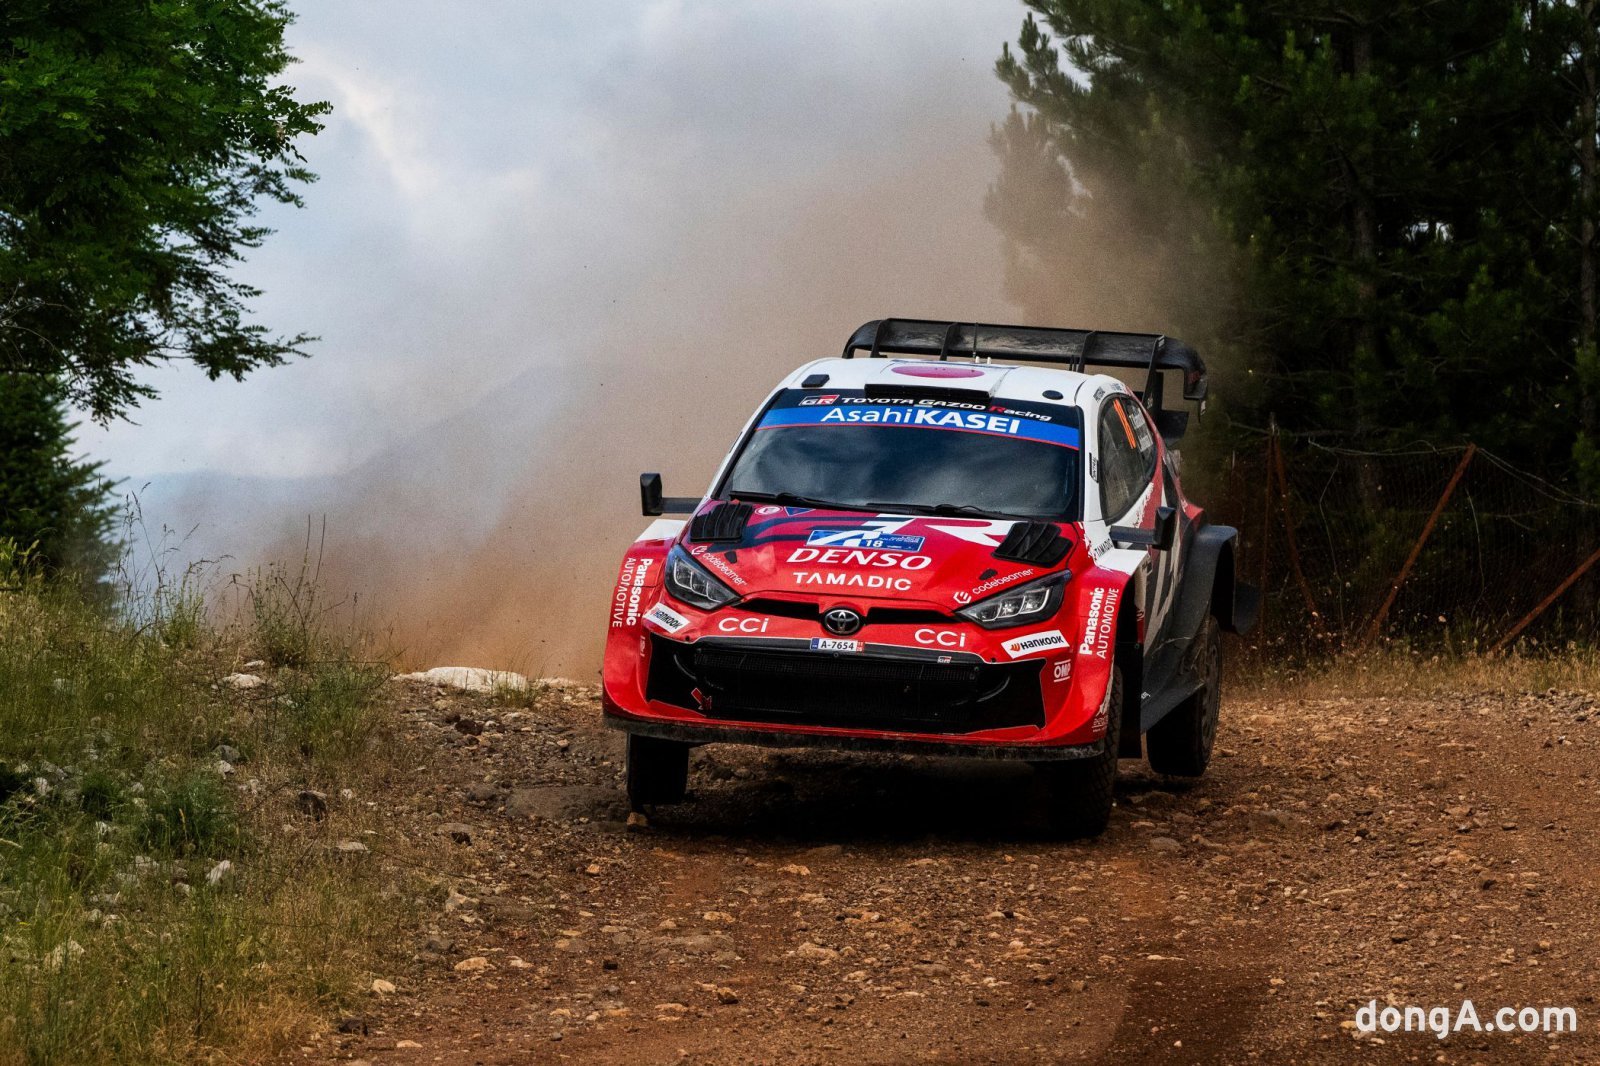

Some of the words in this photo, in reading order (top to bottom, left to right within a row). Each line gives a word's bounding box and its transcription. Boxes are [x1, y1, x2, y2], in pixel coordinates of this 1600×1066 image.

[800, 396, 838, 406] GR
[841, 397, 914, 406] TOYOTA
[918, 399, 986, 411] GAZOO
[988, 405, 1052, 421] Racing
[866, 539, 884, 548] 18
[702, 553, 747, 586] codebeamer
[786, 547, 932, 571] DENSO
[612, 557, 637, 628] AUTOMOTIVE
[626, 558, 654, 626] Panasonic
[792, 572, 912, 591] TAMADIC
[972, 568, 1034, 595] codebeamer
[718, 617, 770, 633] CCi
[1079, 587, 1105, 656] Panasonic
[1096, 587, 1119, 660] AUTOMOTIVE
[820, 640, 855, 650] A-7654
[914, 628, 967, 648] CCi
[1053, 662, 1072, 679] OMP
